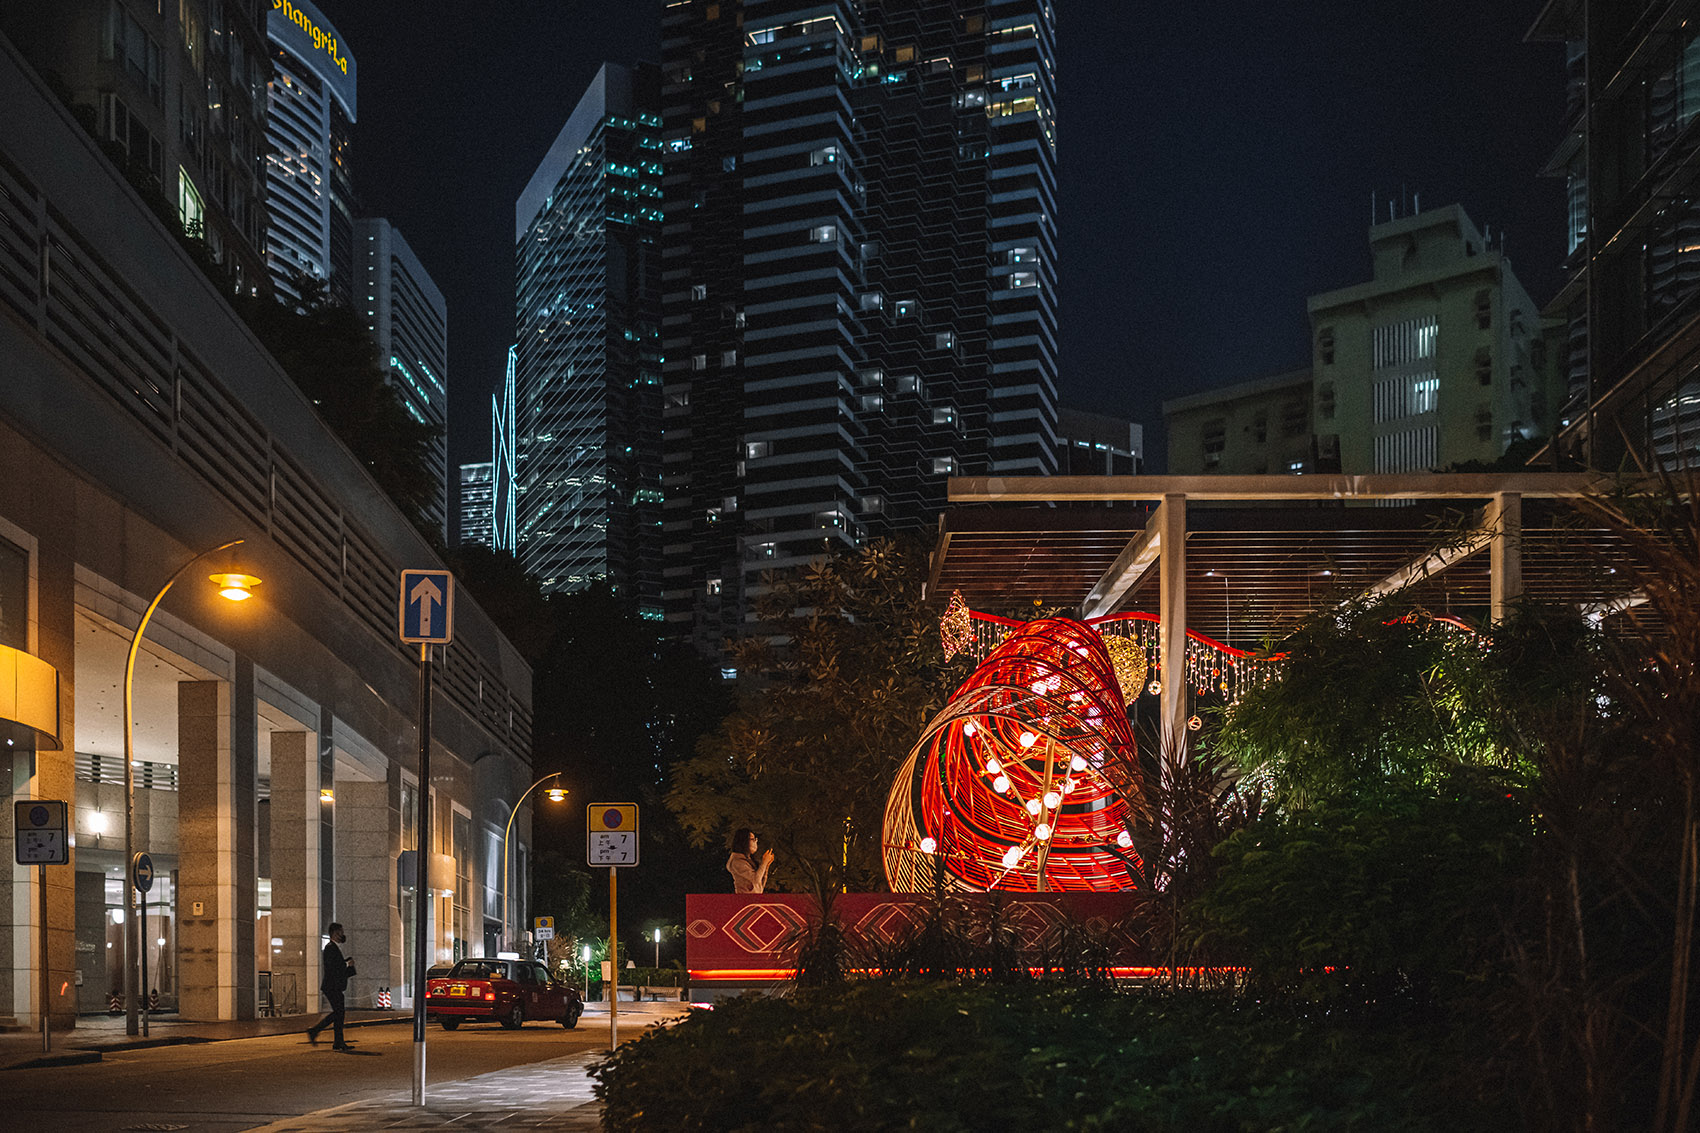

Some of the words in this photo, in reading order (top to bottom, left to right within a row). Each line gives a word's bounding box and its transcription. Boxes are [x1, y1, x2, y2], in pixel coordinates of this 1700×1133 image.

[48, 833, 54, 842] 7
[620, 834, 627, 844] 7
[48, 850, 55, 860] 7
[620, 852, 627, 861] 7
